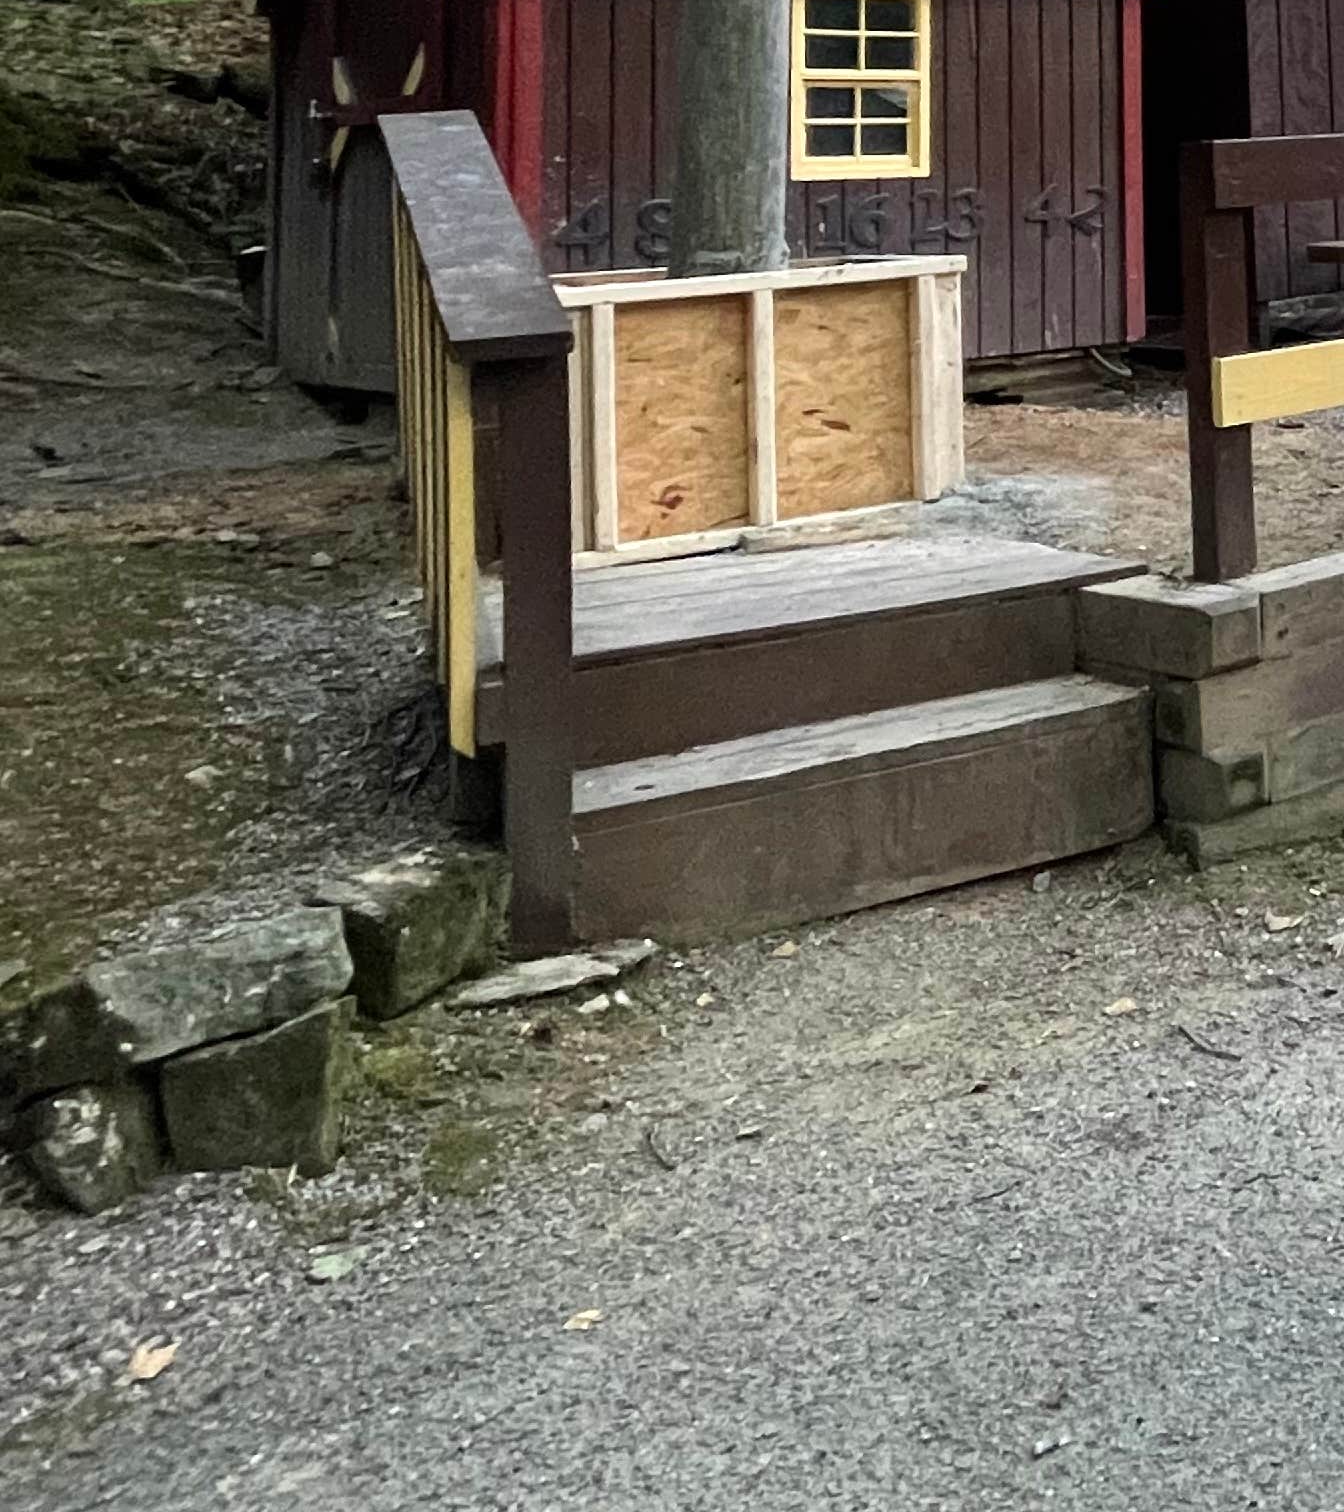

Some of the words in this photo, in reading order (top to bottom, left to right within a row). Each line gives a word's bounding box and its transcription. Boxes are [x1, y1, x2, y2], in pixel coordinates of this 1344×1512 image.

[549, 196, 611, 266] 4
[813, 192, 890, 253] 16
[1023, 183, 1107, 237] 42
